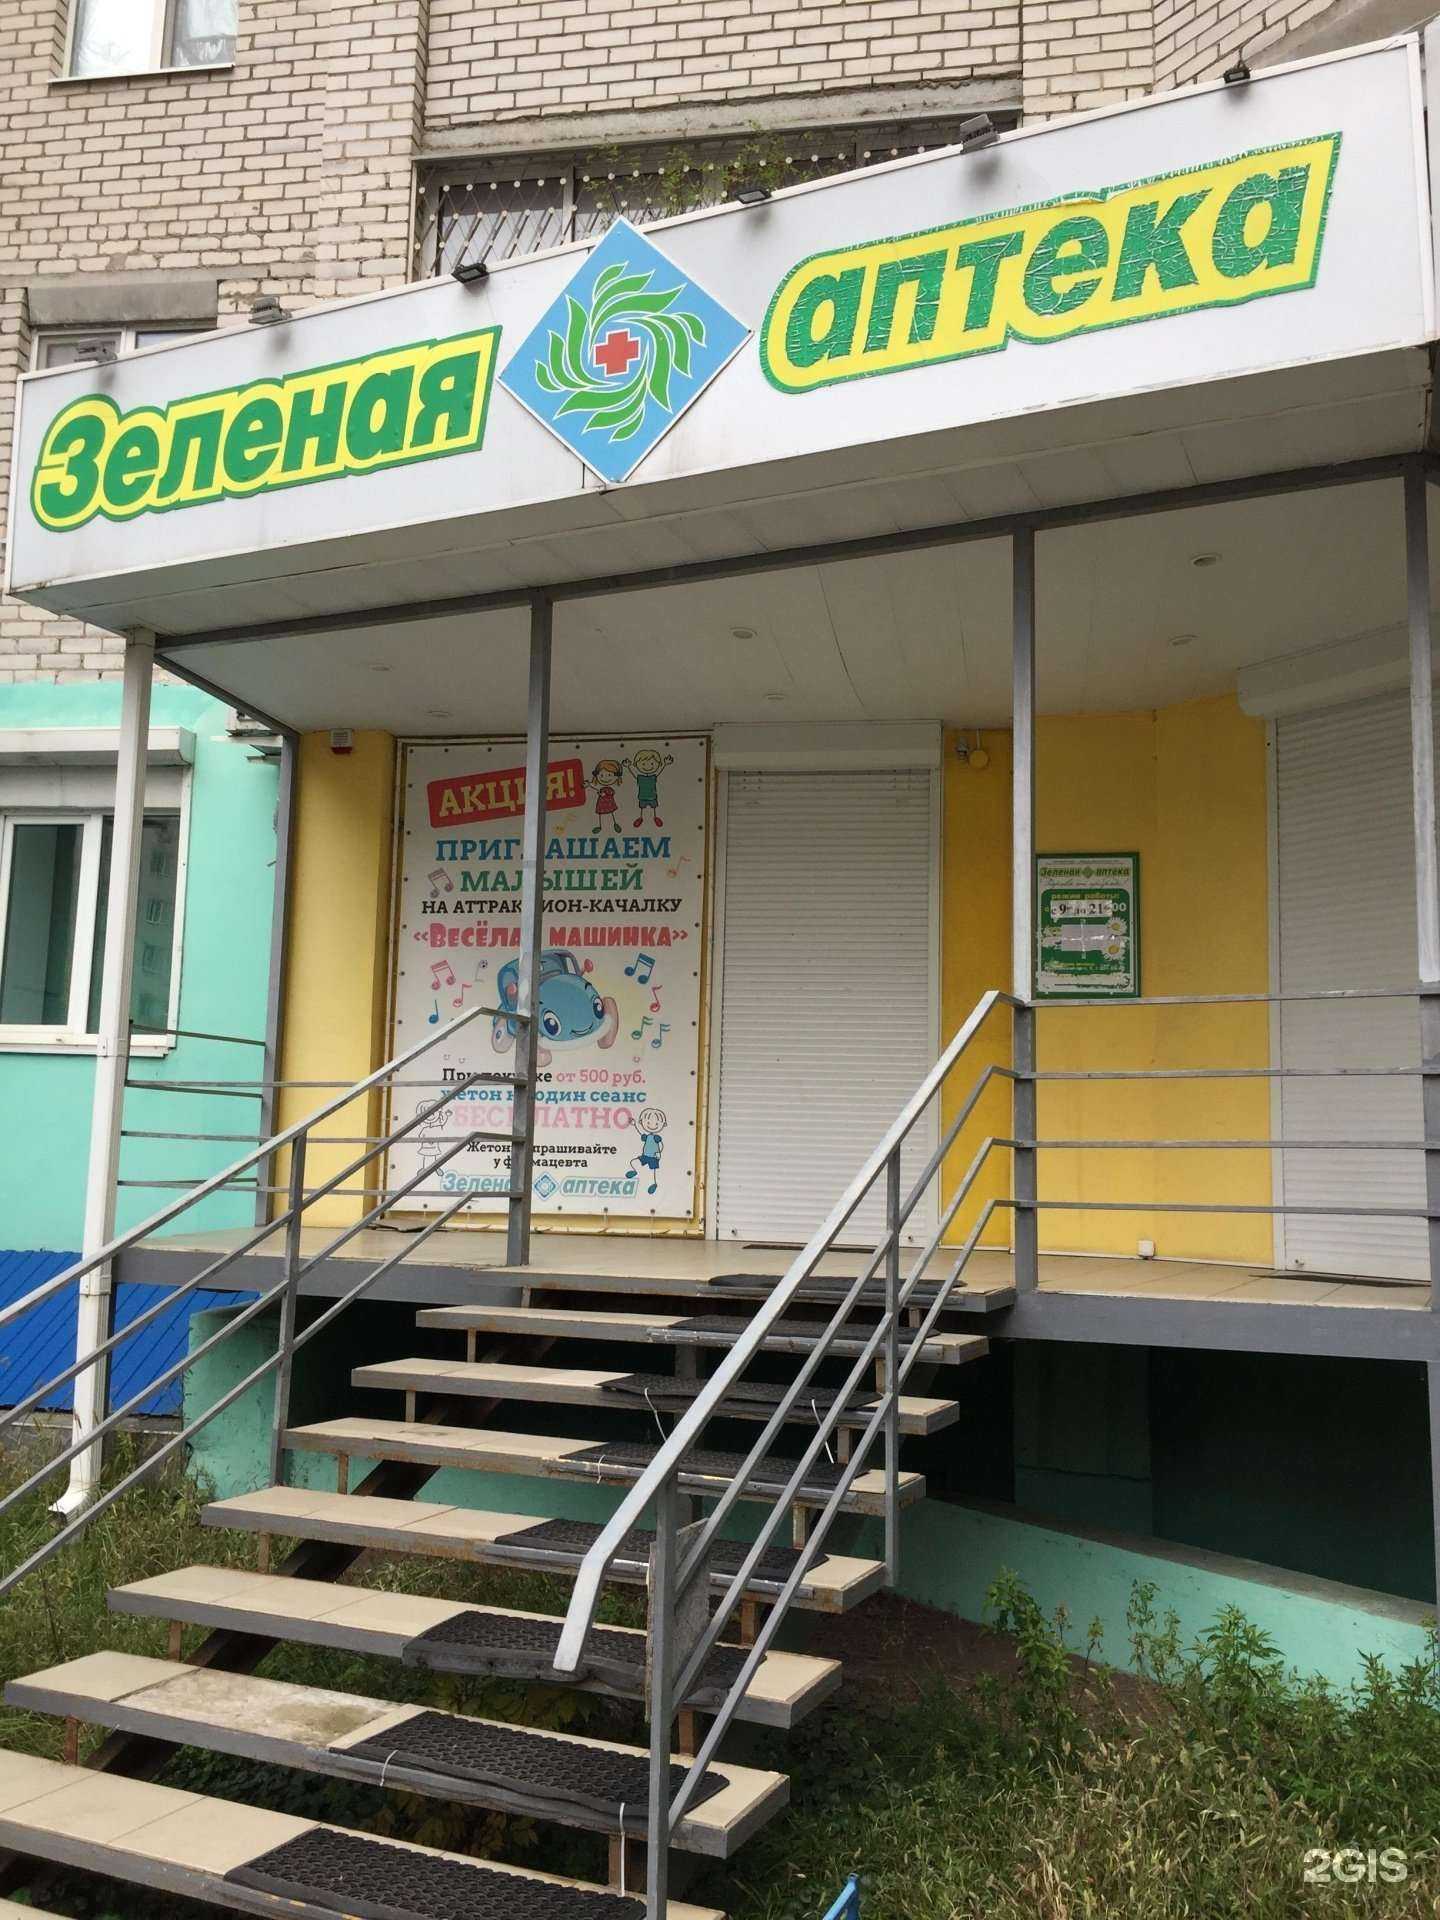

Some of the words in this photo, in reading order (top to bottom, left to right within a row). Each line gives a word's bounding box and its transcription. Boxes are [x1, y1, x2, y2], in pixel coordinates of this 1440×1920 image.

[38, 350, 481, 520] Зеленая
[784, 162, 1312, 368] аптека
[435, 836, 671, 861] ПРИГАШАЕМ
[422, 900, 448, 914] НА
[453, 898, 682, 914] АТТРАКИОН-КАЧАЛКУ
[556, 1072, 576, 1083] от
[579, 1069, 609, 1083] 500
[612, 1069, 646, 1087] руб.
[590, 1091, 647, 1102] сеанс
[467, 1141, 512, 1153] Жетон
[533, 1143, 617, 1156] прашивайте
[493, 1158, 501, 1169] у
[503, 1155, 588, 1169] фмацевта
[562, 1179, 636, 1195] аптека
